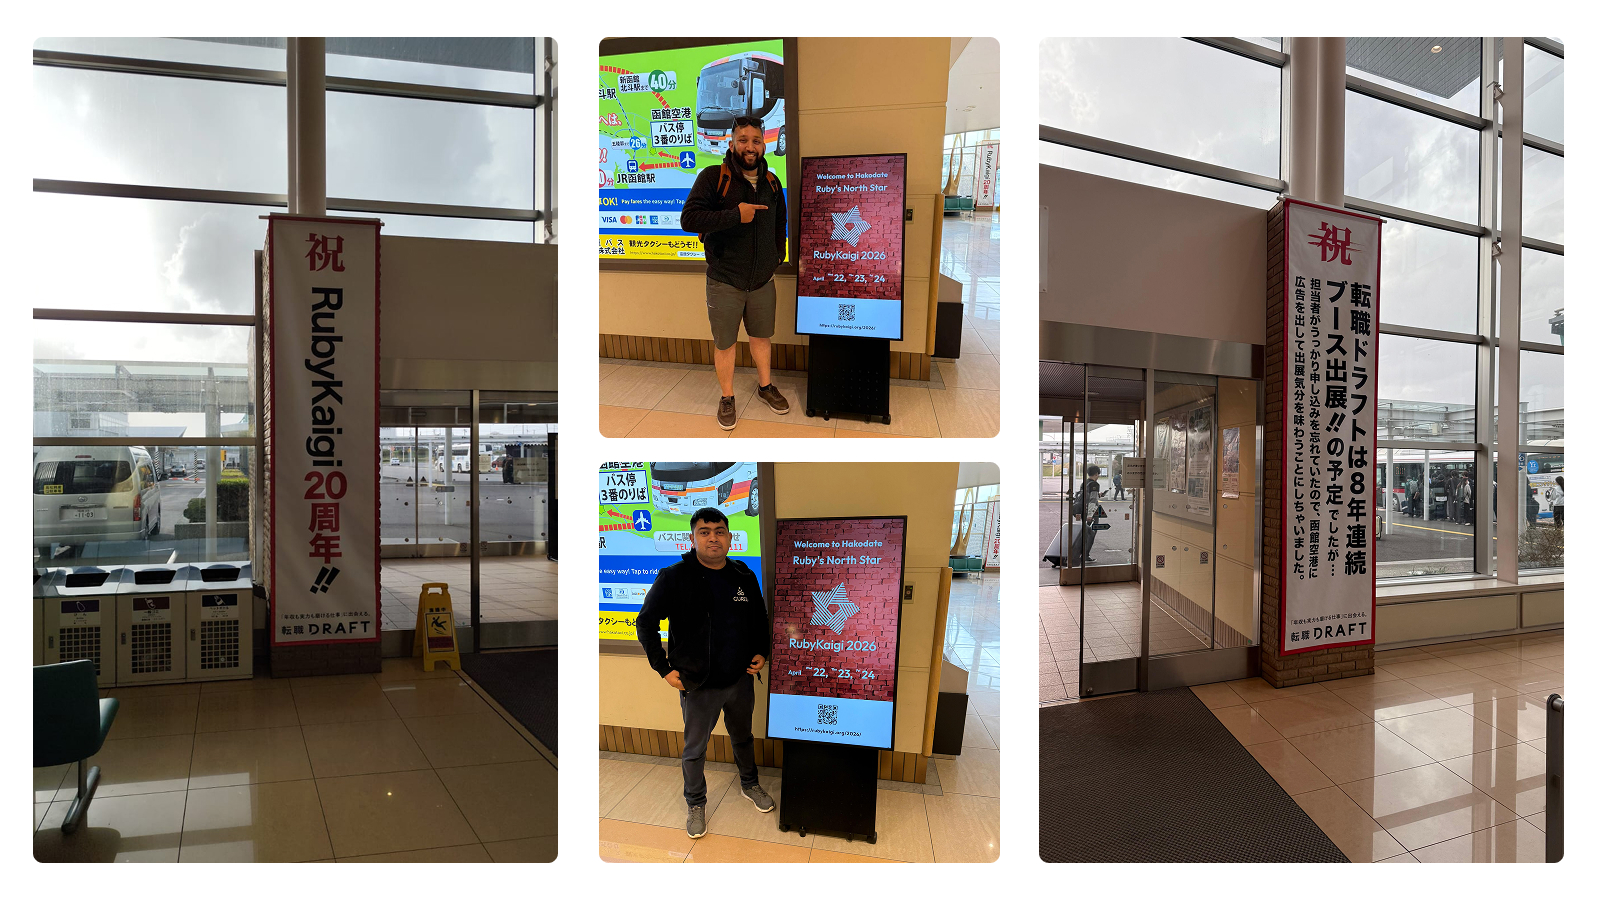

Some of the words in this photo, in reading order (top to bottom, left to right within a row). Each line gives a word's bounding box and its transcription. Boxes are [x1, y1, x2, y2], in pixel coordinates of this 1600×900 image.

[652, 108, 692, 120] 函館空港
[654, 122, 684, 133] バス停
[654, 133, 692, 145] 3番のりば
[617, 173, 656, 184] JR函館駅
[816, 184, 842, 194] Ruby's
[1317, 221, 1352, 266] 祝
[304, 232, 346, 272] 祝
[814, 250, 859, 261] RubyKaigi
[860, 250, 886, 260] 2026
[1294, 276, 1306, 580] 広告を出して出展気分を味わうことにしちゃいました。
[1308, 278, 1321, 578] 担当者がうっかり申し込みを忘れていたので、函館空港に
[1345, 282, 1372, 576] 転職ドラフトは8年連続
[606, 472, 636, 486] バス停
[601, 487, 646, 501] 3番のりば
[792, 556, 824, 567] Ruby's
[826, 556, 856, 564] North
[859, 555, 882, 564] Star
[282, 625, 304, 636] 転職
[308, 621, 370, 635] DRAFT
[1290, 630, 1310, 642] 転職
[1314, 622, 1366, 640] DRAFT
[789, 638, 844, 652] RubyKaigi
[846, 640, 876, 651] 2026
[813, 668, 828, 678] 22,
[838, 669, 852, 680] 23,
[862, 670, 875, 680] 24
[794, 726, 862, 737] https://rubykaigi.org/2026/
